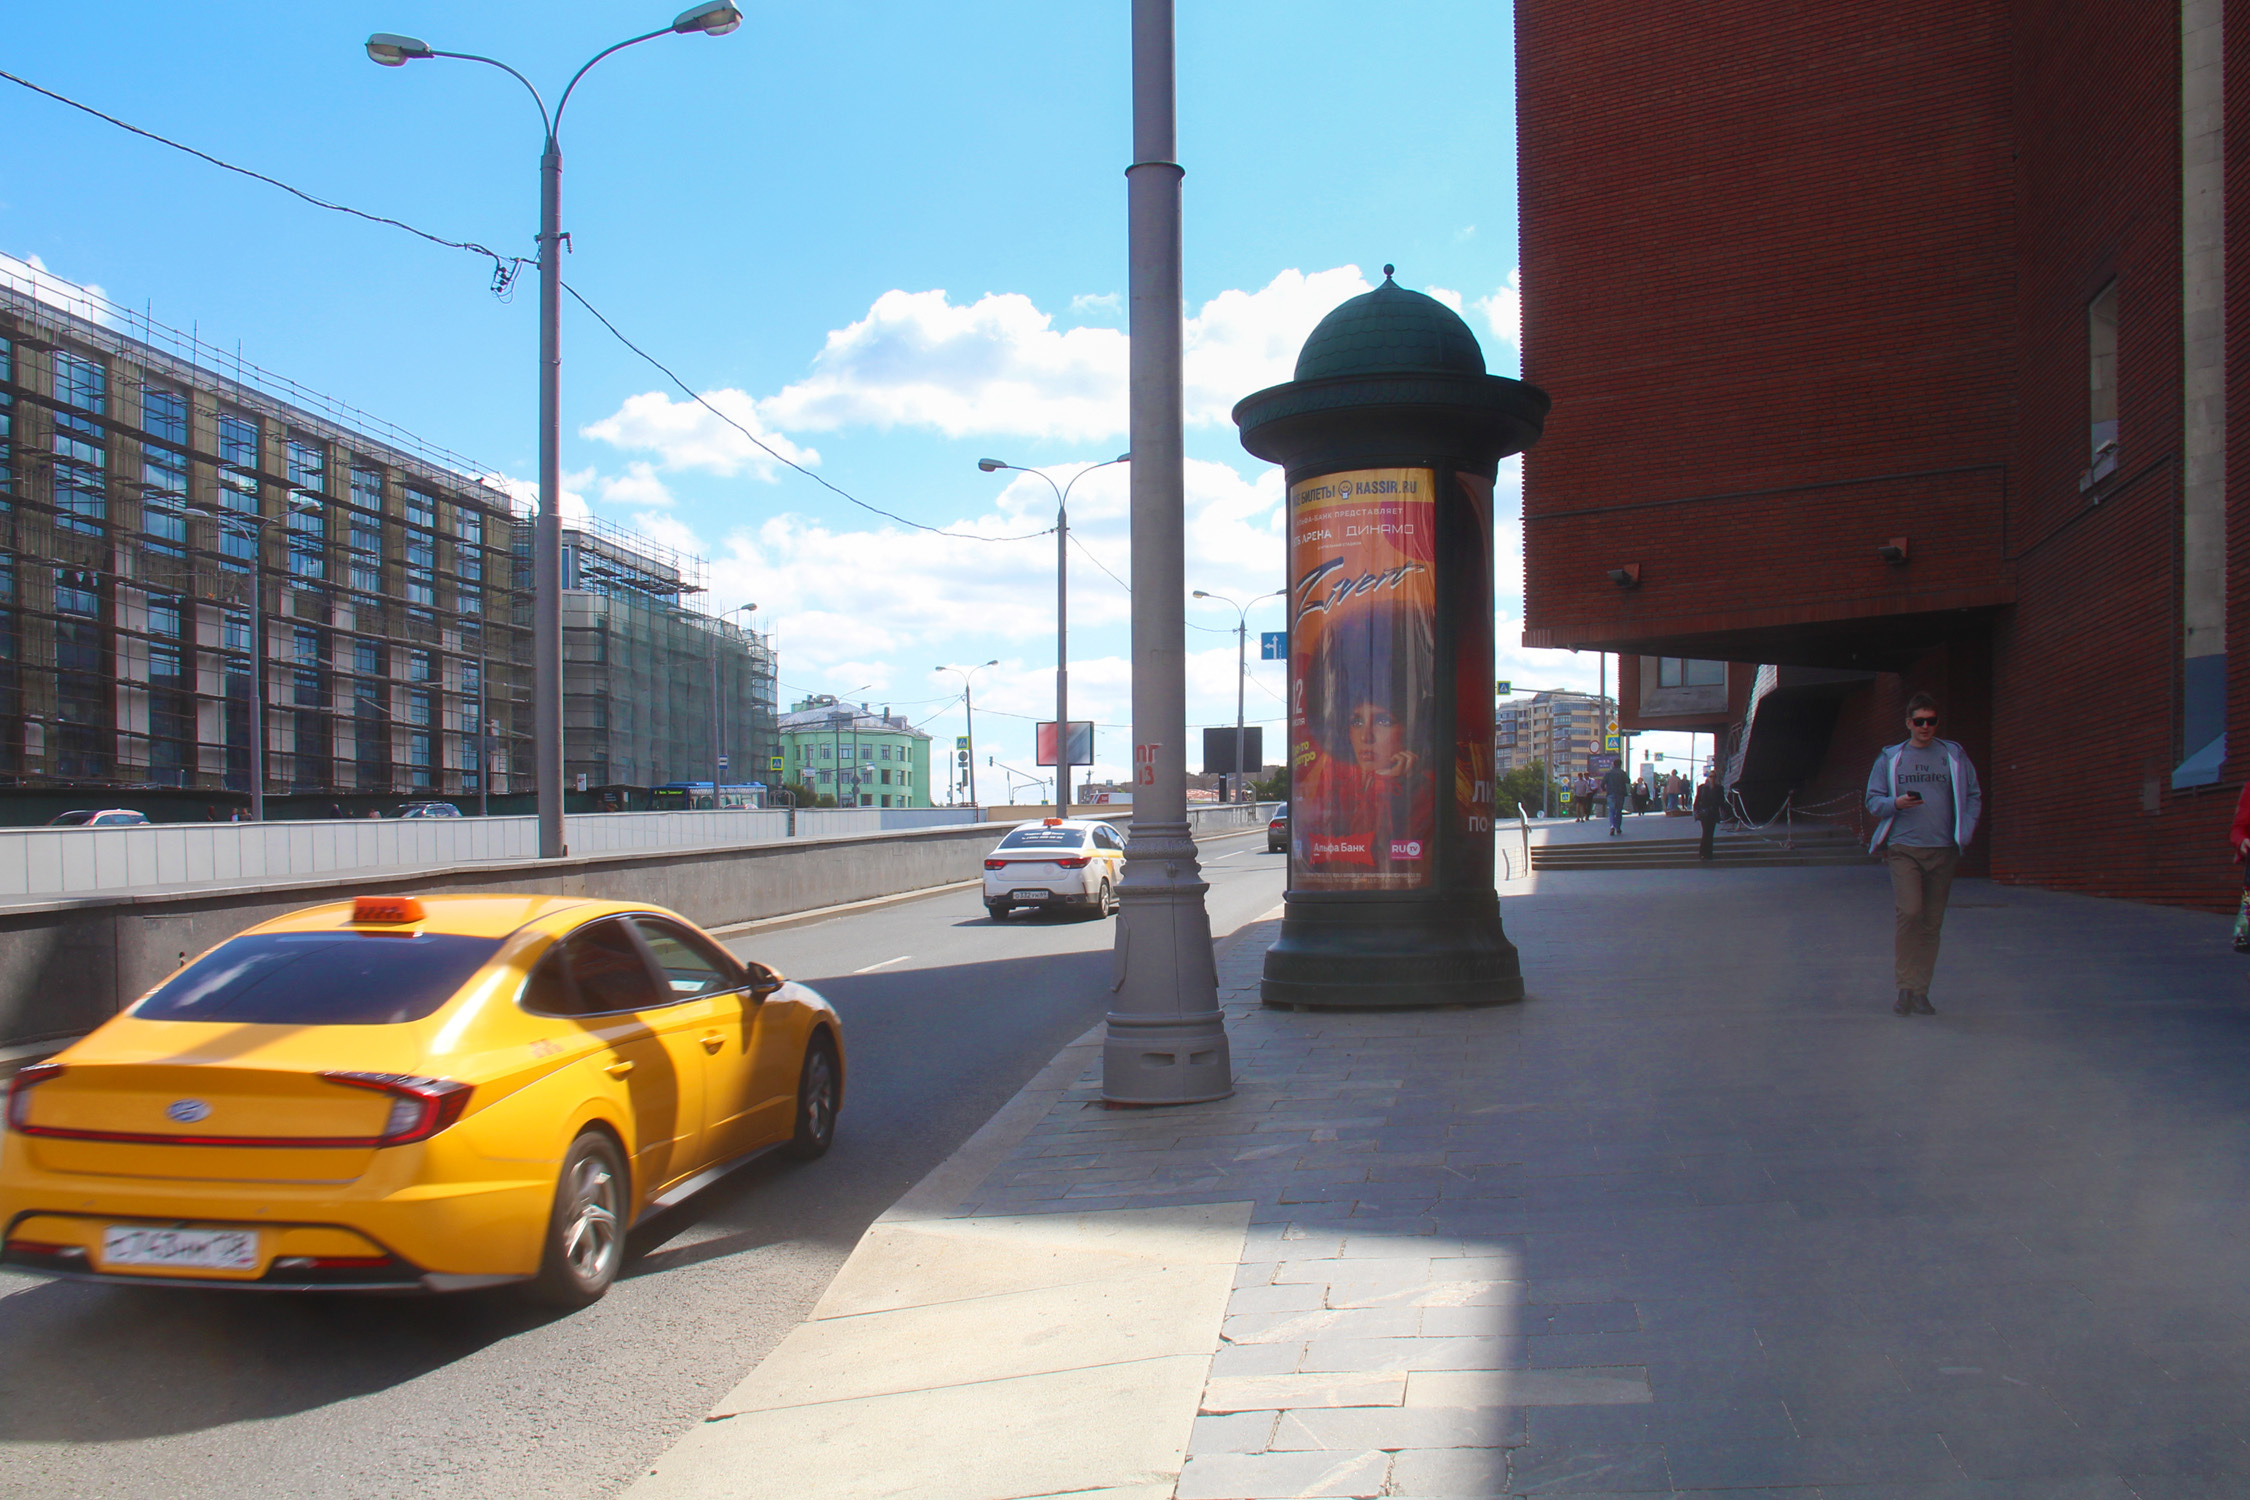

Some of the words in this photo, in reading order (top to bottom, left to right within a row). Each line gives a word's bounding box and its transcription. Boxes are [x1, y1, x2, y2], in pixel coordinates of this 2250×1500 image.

[1301, 485, 1336, 505] БИЛЕТЫ
[1356, 480, 1418, 495] KASSIR.RU
[1335, 507, 1403, 519] ПРЕДСТАВЛЯЕТ
[1302, 529, 1332, 544] АРЕНА
[1346, 523, 1415, 537] ДИНАМО
[1293, 556, 1425, 634] Zivert
[1915, 764, 1930, 772] Fly
[1897, 772, 1947, 785] Emirates
[1313, 842, 1339, 855] Альфа
[1341, 842, 1365, 852] Банк
